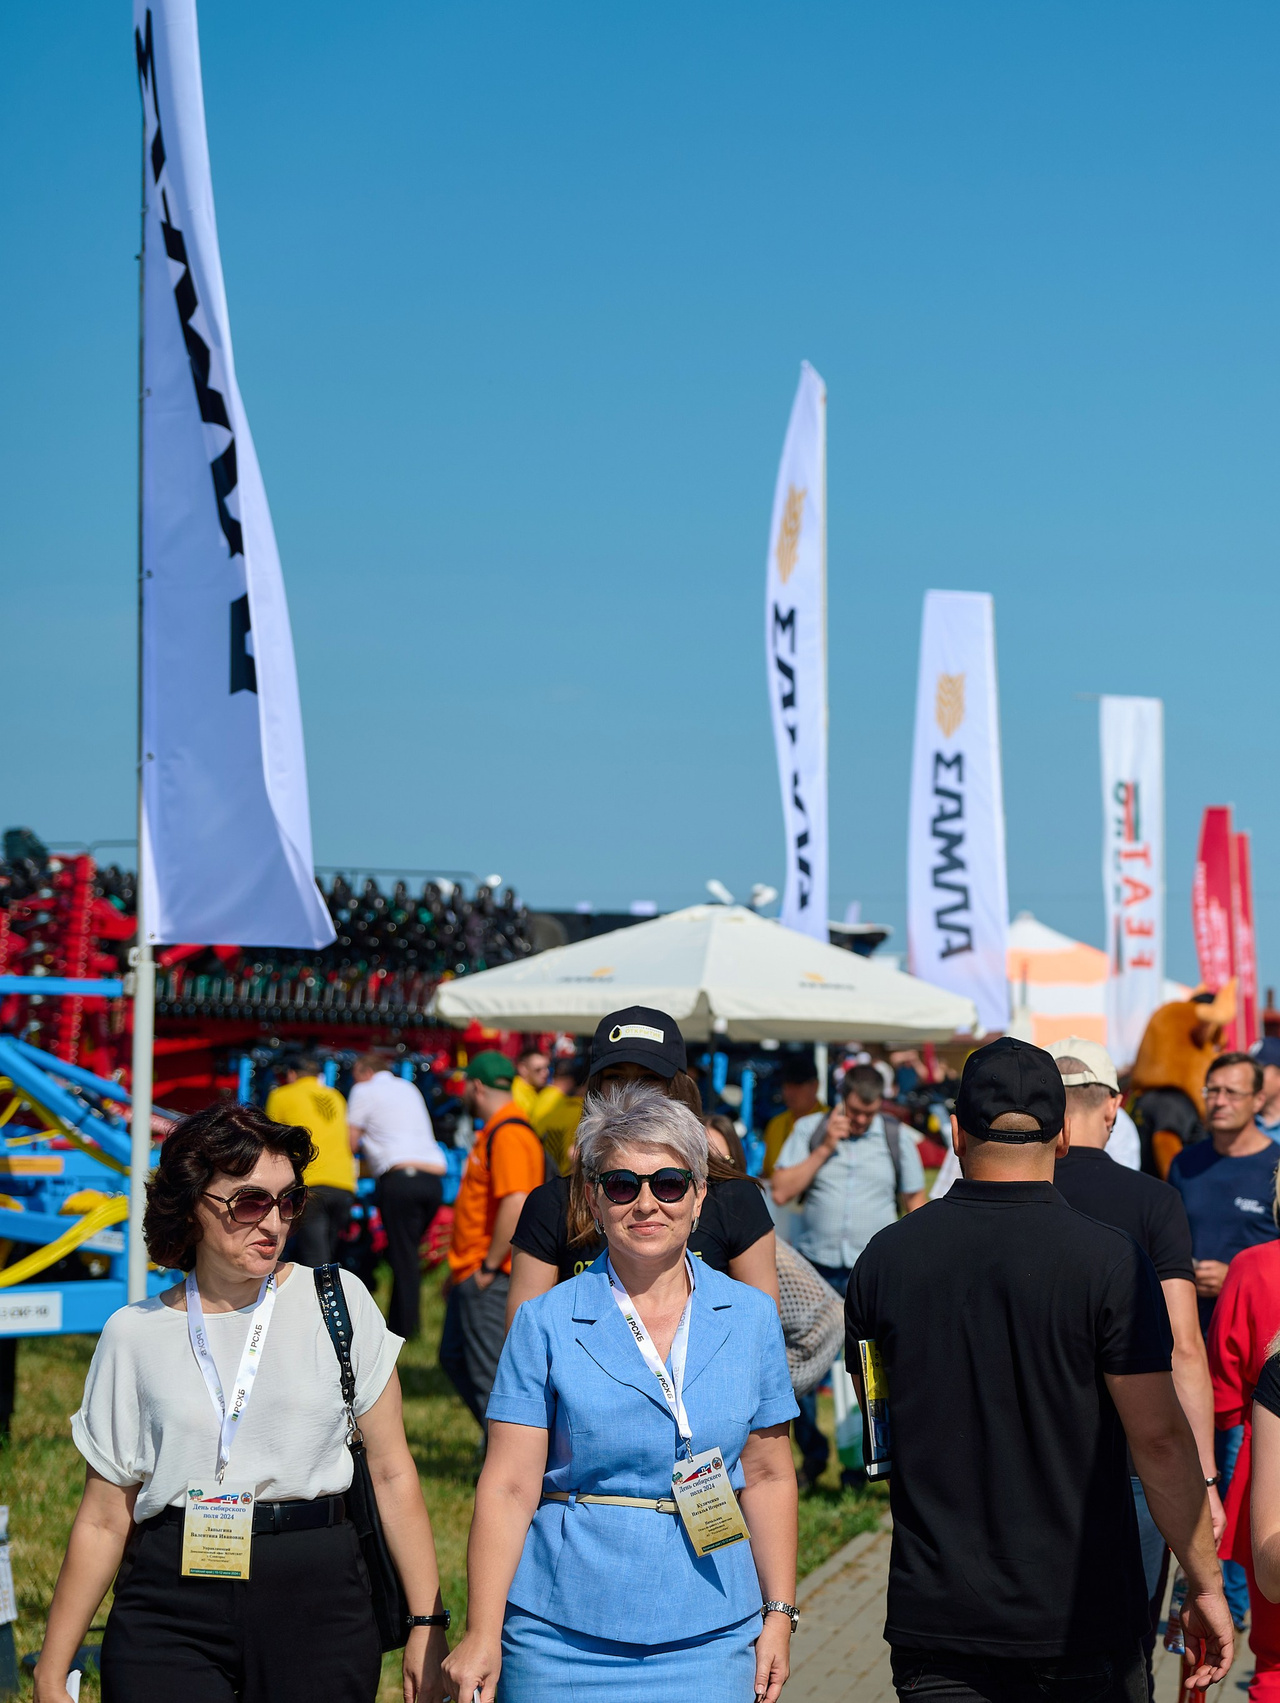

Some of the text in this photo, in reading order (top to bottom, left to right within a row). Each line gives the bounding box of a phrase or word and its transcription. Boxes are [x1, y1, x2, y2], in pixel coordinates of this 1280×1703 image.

[251, 1324, 263, 1348] РСХБ
[628, 1320, 645, 1343] РСХБ
[659, 1377, 674, 1400] РСХБ
[234, 1389, 246, 1413] РСХБ
[704, 1483, 715, 1493] 2024
